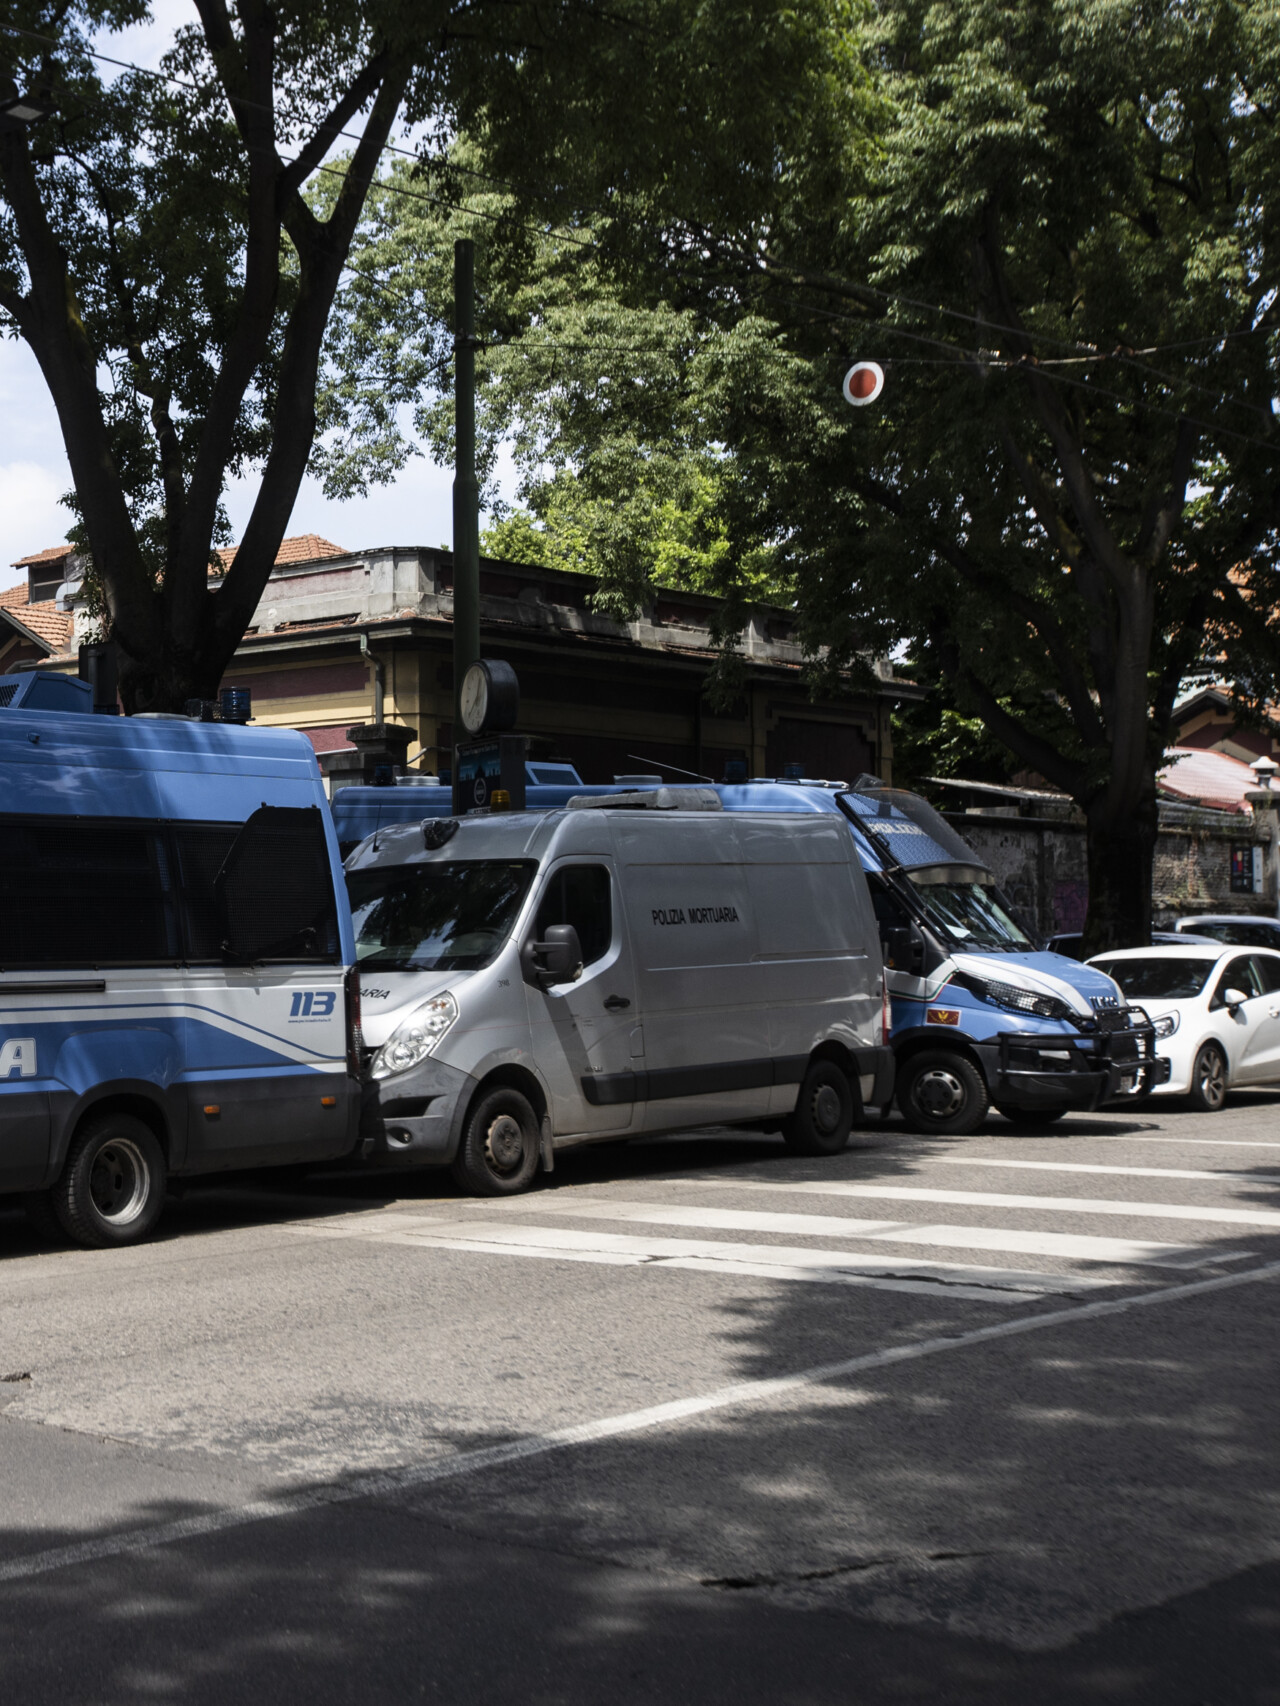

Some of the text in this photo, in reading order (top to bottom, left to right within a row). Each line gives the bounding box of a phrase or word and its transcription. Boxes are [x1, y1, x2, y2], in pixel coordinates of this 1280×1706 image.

[651, 906, 740, 926] POLIZIA MORTUARIA
[289, 991, 337, 1017] 113
[359, 988, 391, 1000] ARIA
